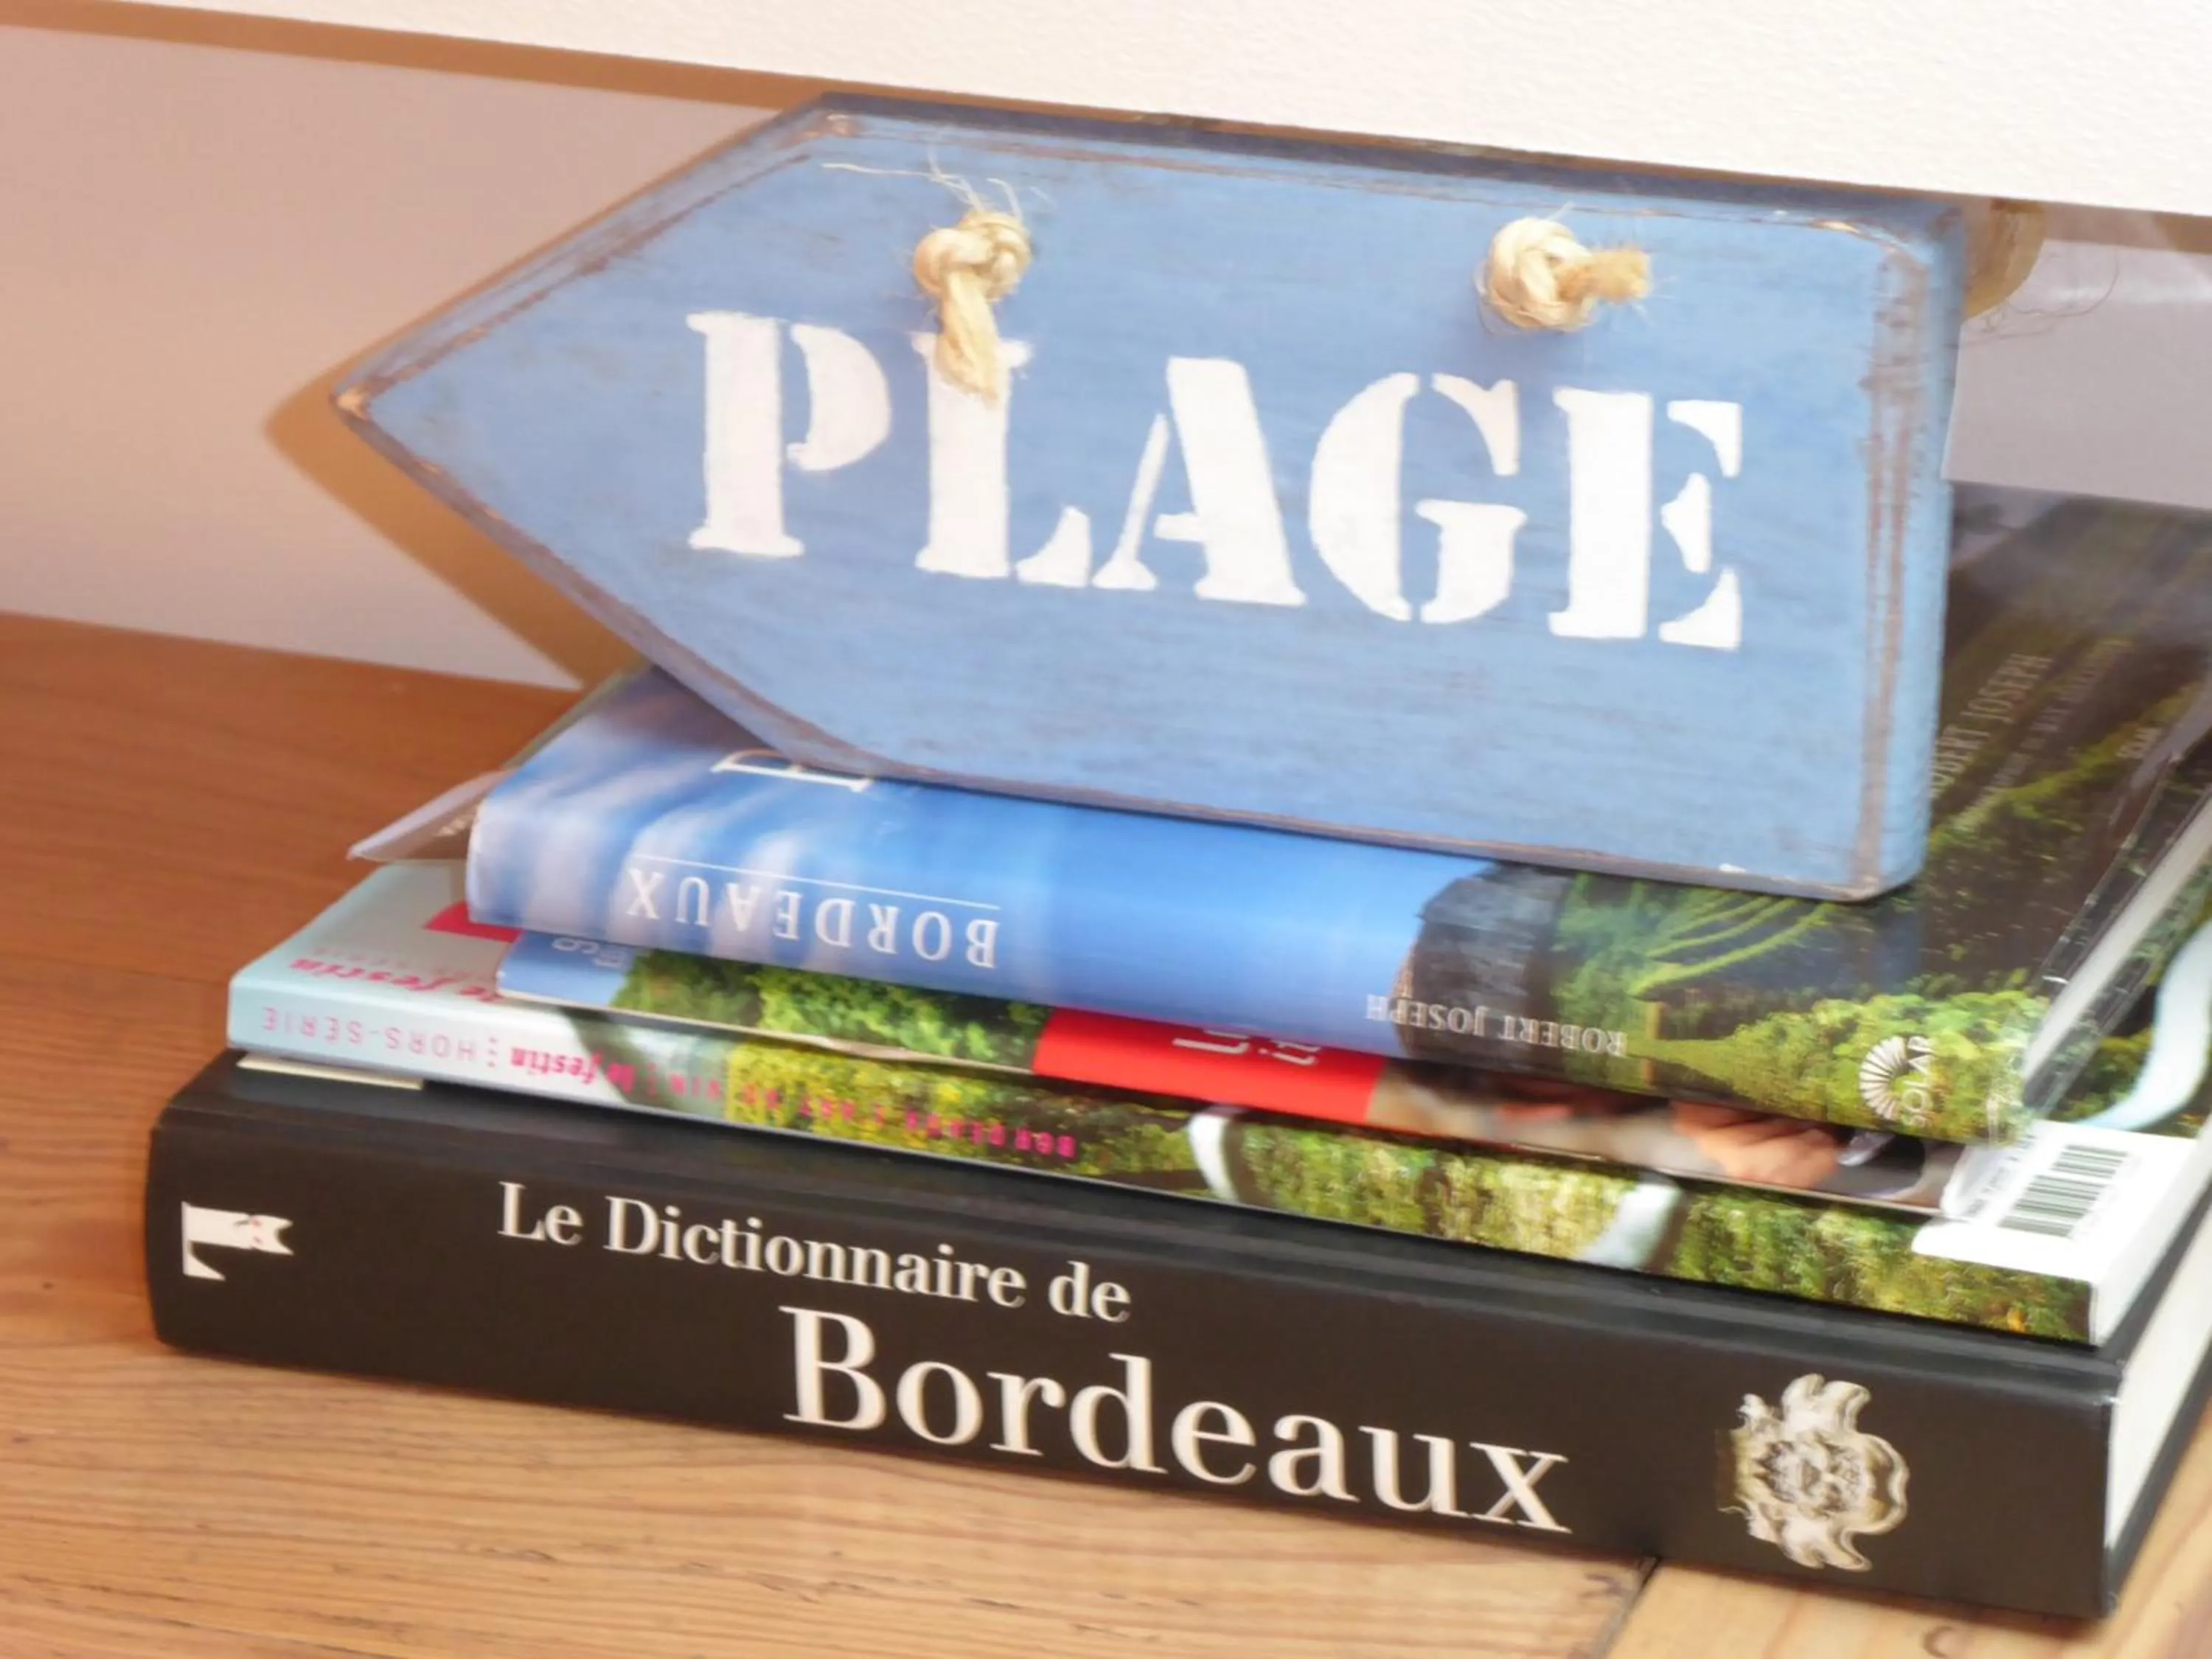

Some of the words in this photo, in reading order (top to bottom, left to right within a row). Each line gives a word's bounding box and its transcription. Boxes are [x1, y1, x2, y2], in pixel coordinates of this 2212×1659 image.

[686, 310, 1742, 651] PLAGE
[626, 867, 1001, 970] BORDEAUX
[1366, 993, 1488, 1034] JOSEPH
[1500, 1012, 1627, 1057] ROBERT
[509, 1044, 605, 1086] festin
[608, 1055, 636, 1092] le
[497, 1181, 583, 1246] Le
[602, 1195, 1028, 1309] Dictionnaire
[1047, 1260, 1132, 1323] de
[778, 1305, 1572, 1534] Bordeaux
